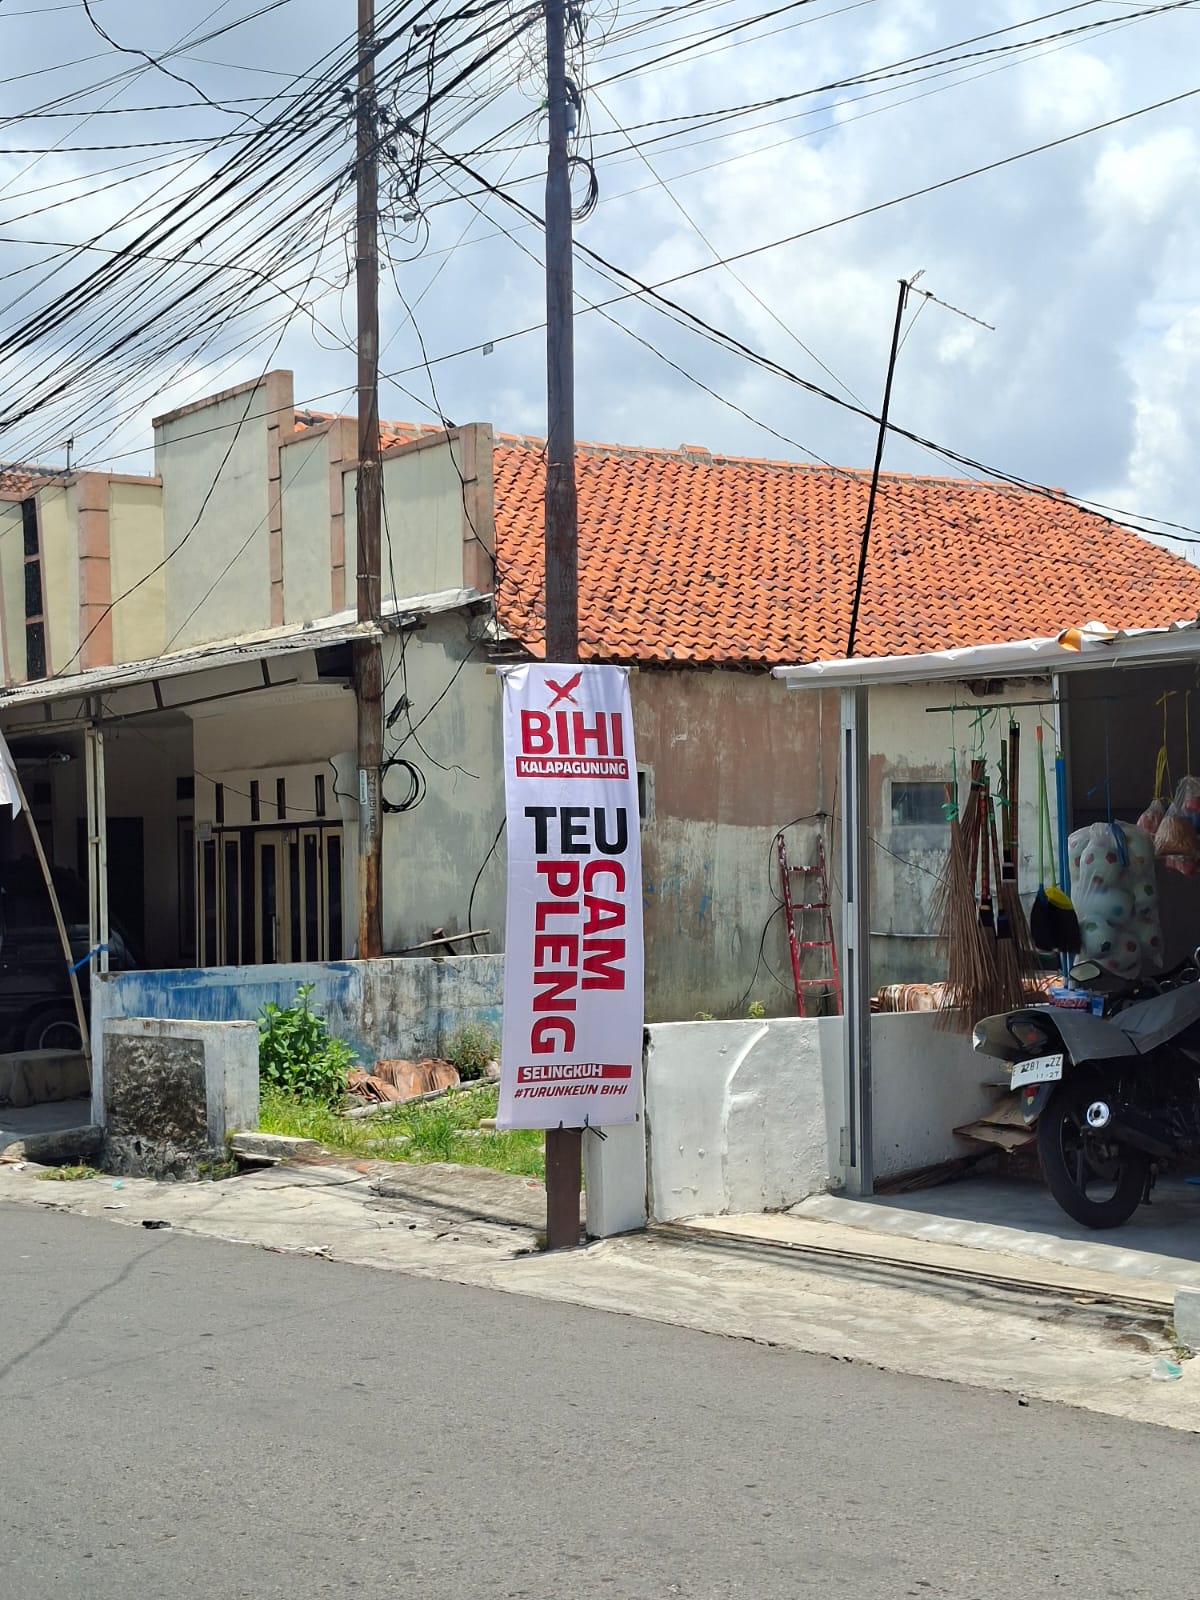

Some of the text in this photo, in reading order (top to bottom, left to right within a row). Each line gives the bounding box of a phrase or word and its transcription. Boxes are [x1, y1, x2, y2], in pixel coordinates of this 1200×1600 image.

[521, 710, 624, 756] BIHI
[520, 760, 626, 775] KALAPAGUNUNG
[524, 806, 628, 855] TEU
[581, 859, 626, 990] CAM
[530, 860, 580, 1054] PLENG
[514, 1084, 628, 1099] #TURUNKEUN BIHI
[523, 1064, 603, 1080] SELINGKUH
